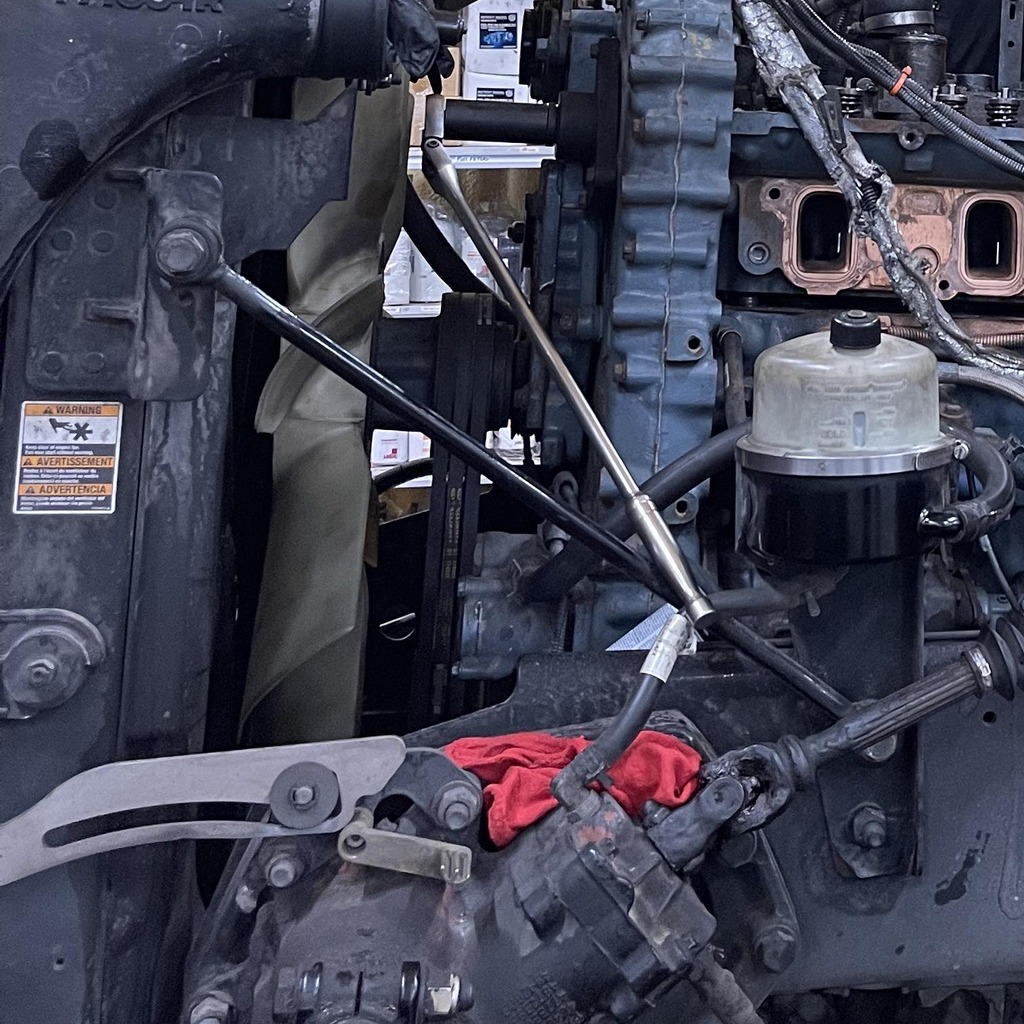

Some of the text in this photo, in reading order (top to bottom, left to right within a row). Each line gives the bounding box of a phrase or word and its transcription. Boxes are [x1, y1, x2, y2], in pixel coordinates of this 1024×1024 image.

[56, 405, 102, 415] WARNING
[37, 457, 113, 467] AVERTISSEMENT
[39, 485, 107, 494] ADVERTENCIA
